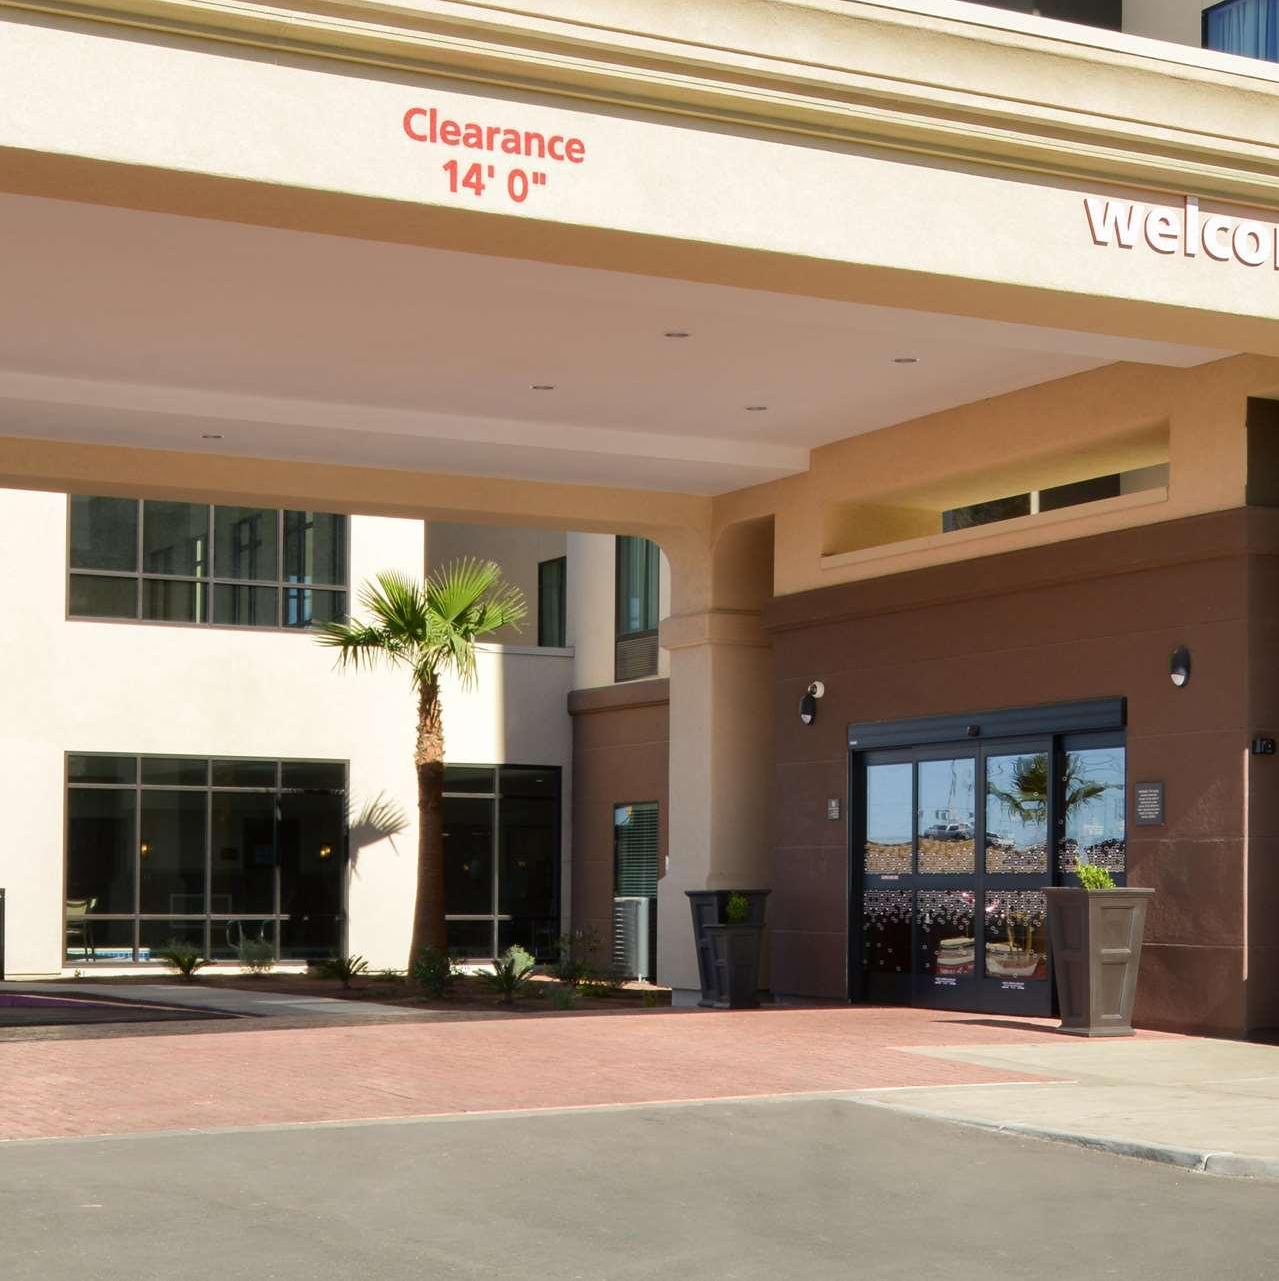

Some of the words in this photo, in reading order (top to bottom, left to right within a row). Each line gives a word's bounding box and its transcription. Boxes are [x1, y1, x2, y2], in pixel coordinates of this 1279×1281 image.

[402, 107, 586, 164] Clearance
[442, 159, 495, 197] 14'
[507, 168, 547, 203] 0"
